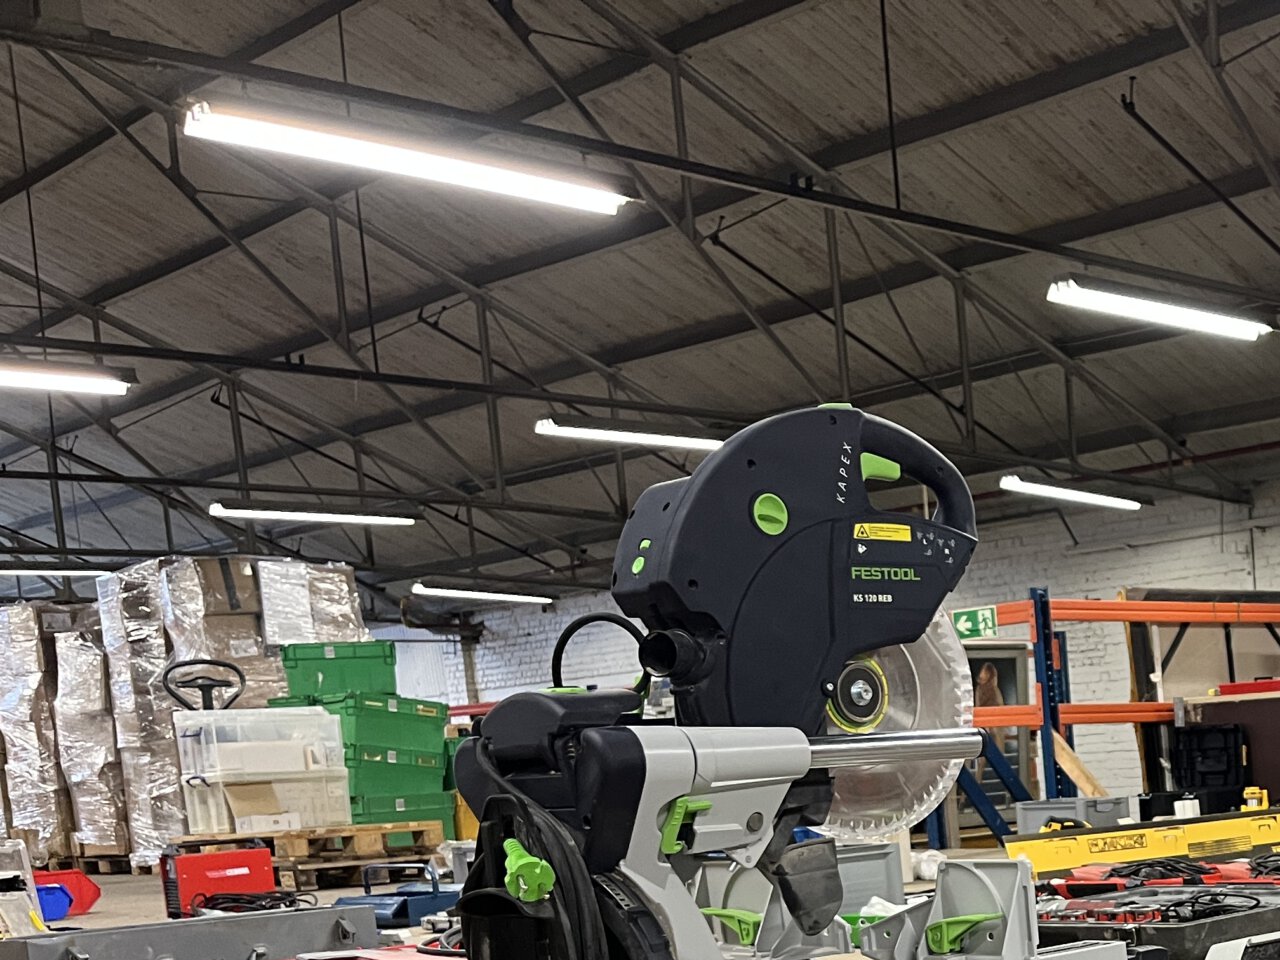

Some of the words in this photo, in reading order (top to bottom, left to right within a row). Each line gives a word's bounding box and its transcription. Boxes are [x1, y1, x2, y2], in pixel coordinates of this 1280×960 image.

[836, 441, 852, 504] KAPEX
[851, 566, 921, 581] FESTOOL
[853, 594, 864, 602] KS
[864, 594, 878, 603] 120
[877, 595, 893, 603] REB
